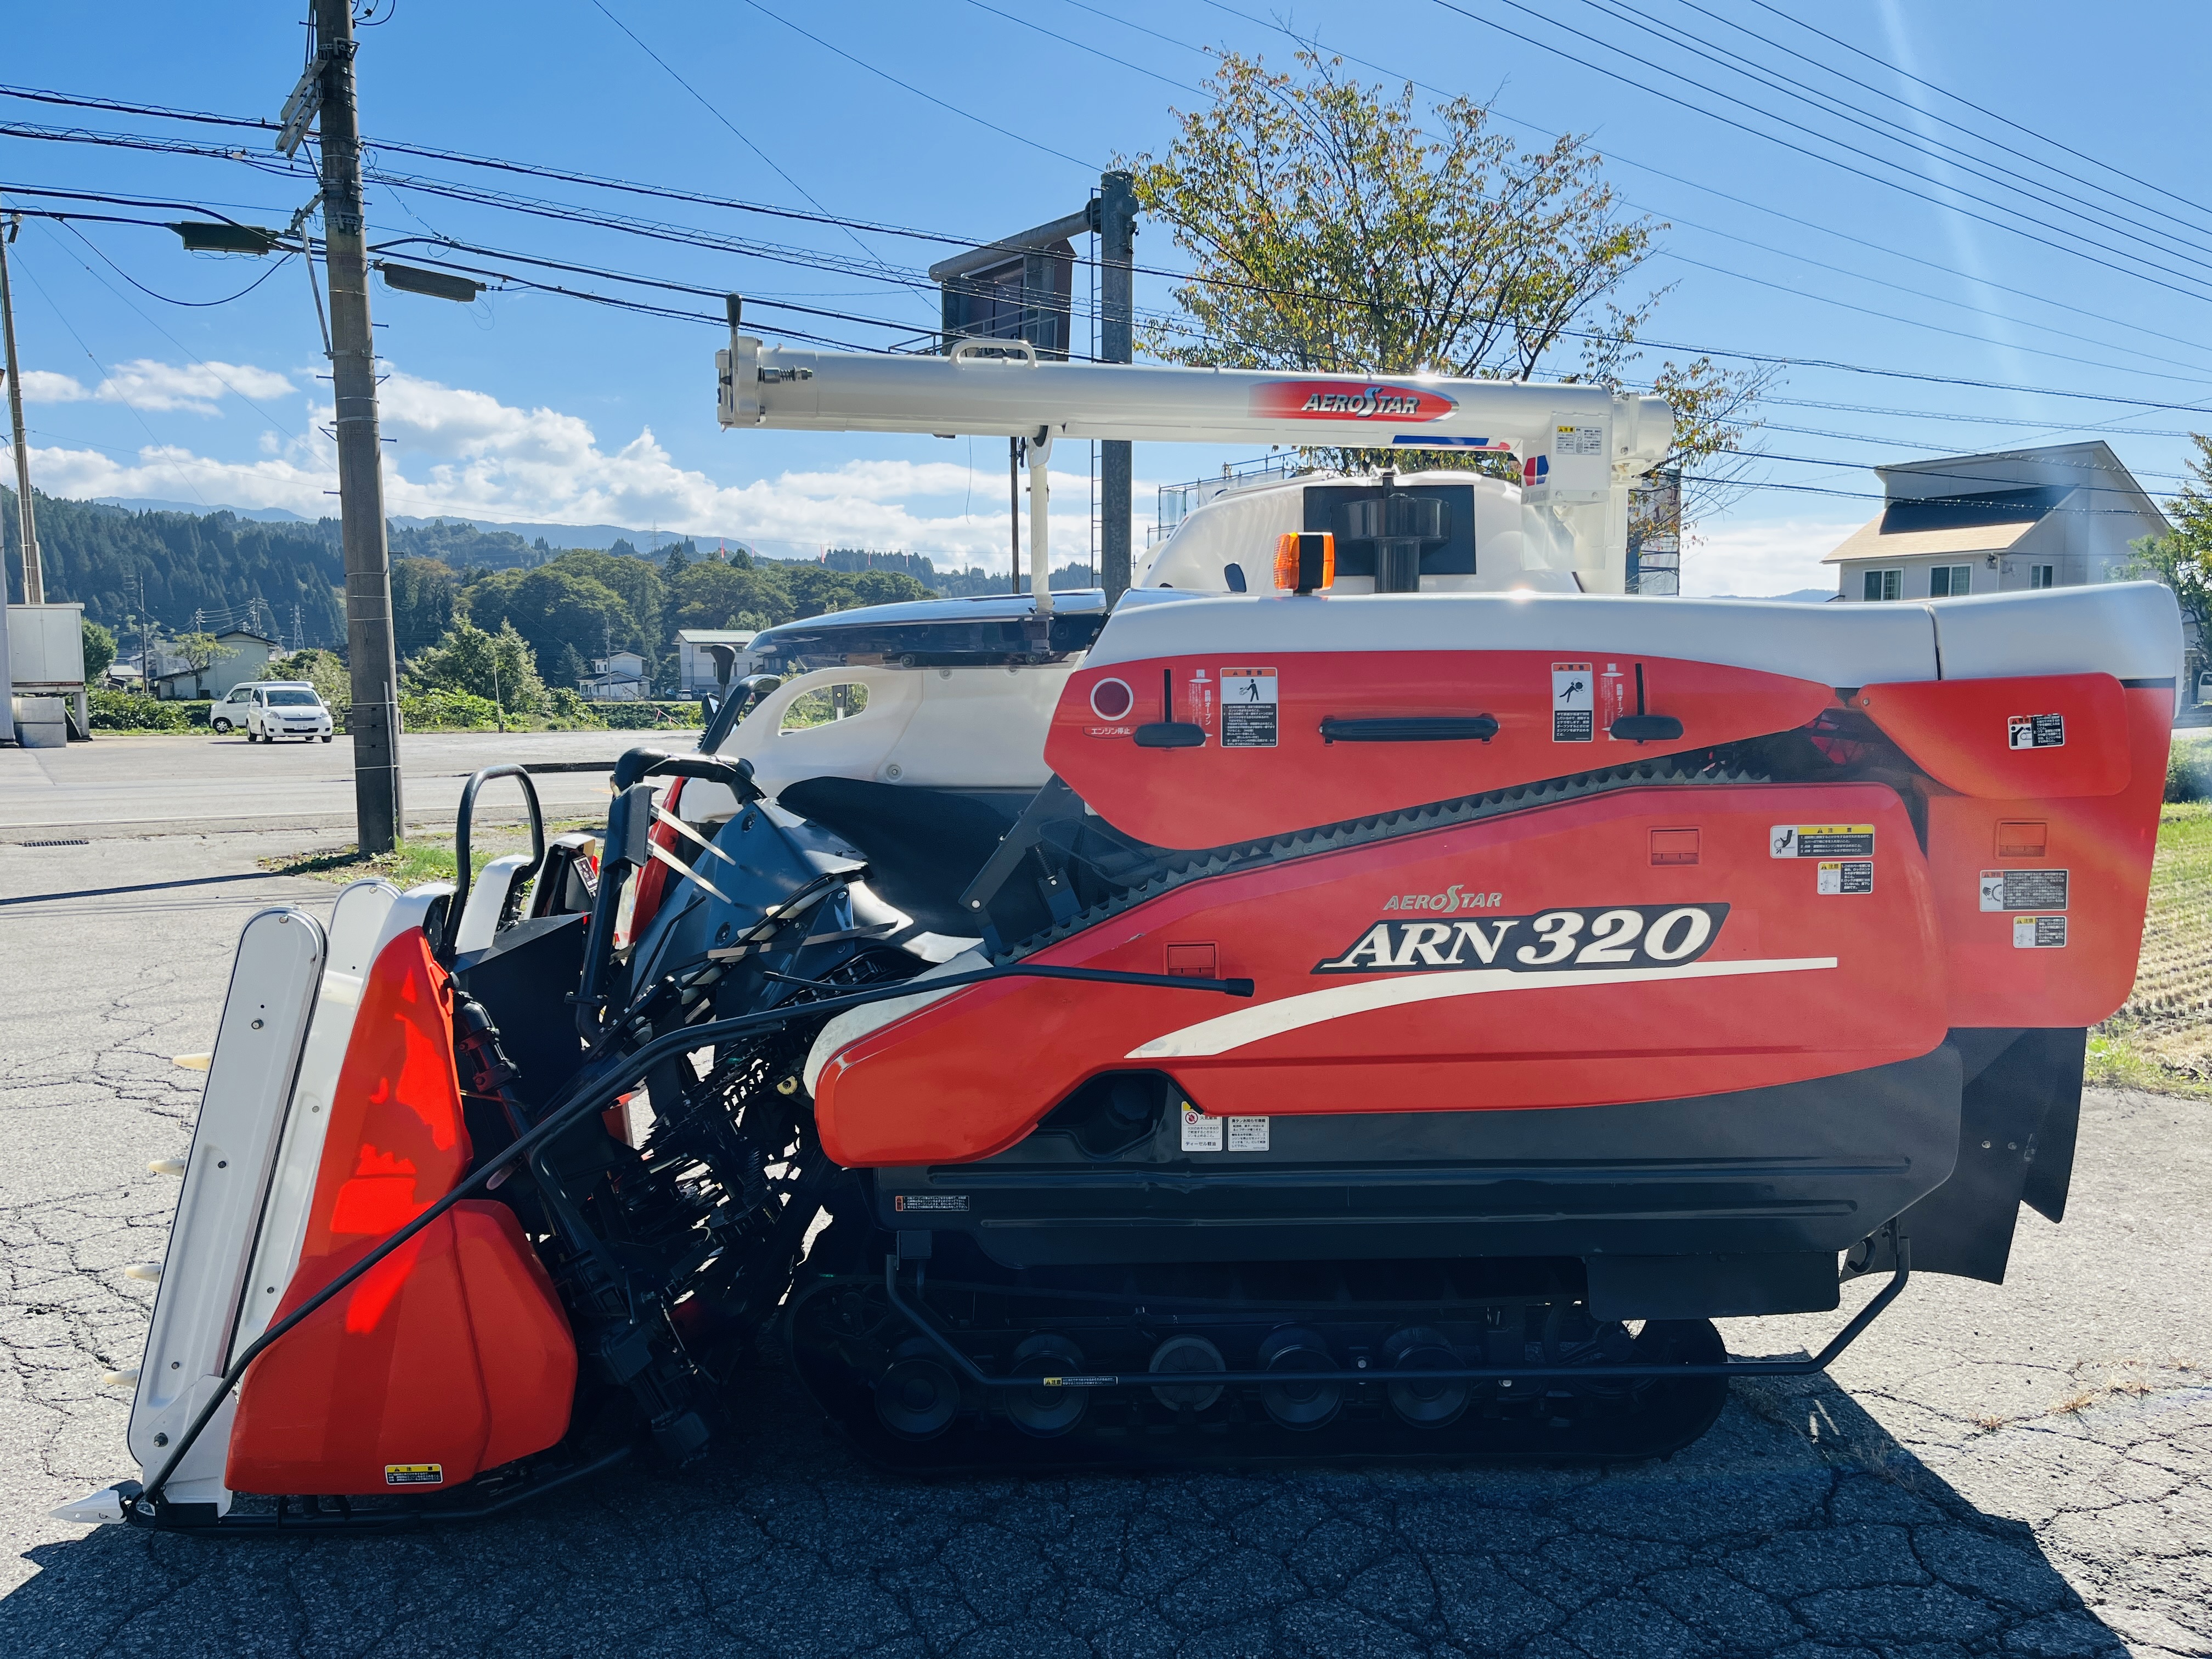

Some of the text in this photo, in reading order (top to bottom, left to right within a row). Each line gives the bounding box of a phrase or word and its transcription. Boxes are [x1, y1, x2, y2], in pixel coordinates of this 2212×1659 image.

[1301, 387, 1421, 417] AEROSTAR
[1383, 884, 1502, 913] AEROSTAR
[1320, 909, 1712, 968] ARN 320
